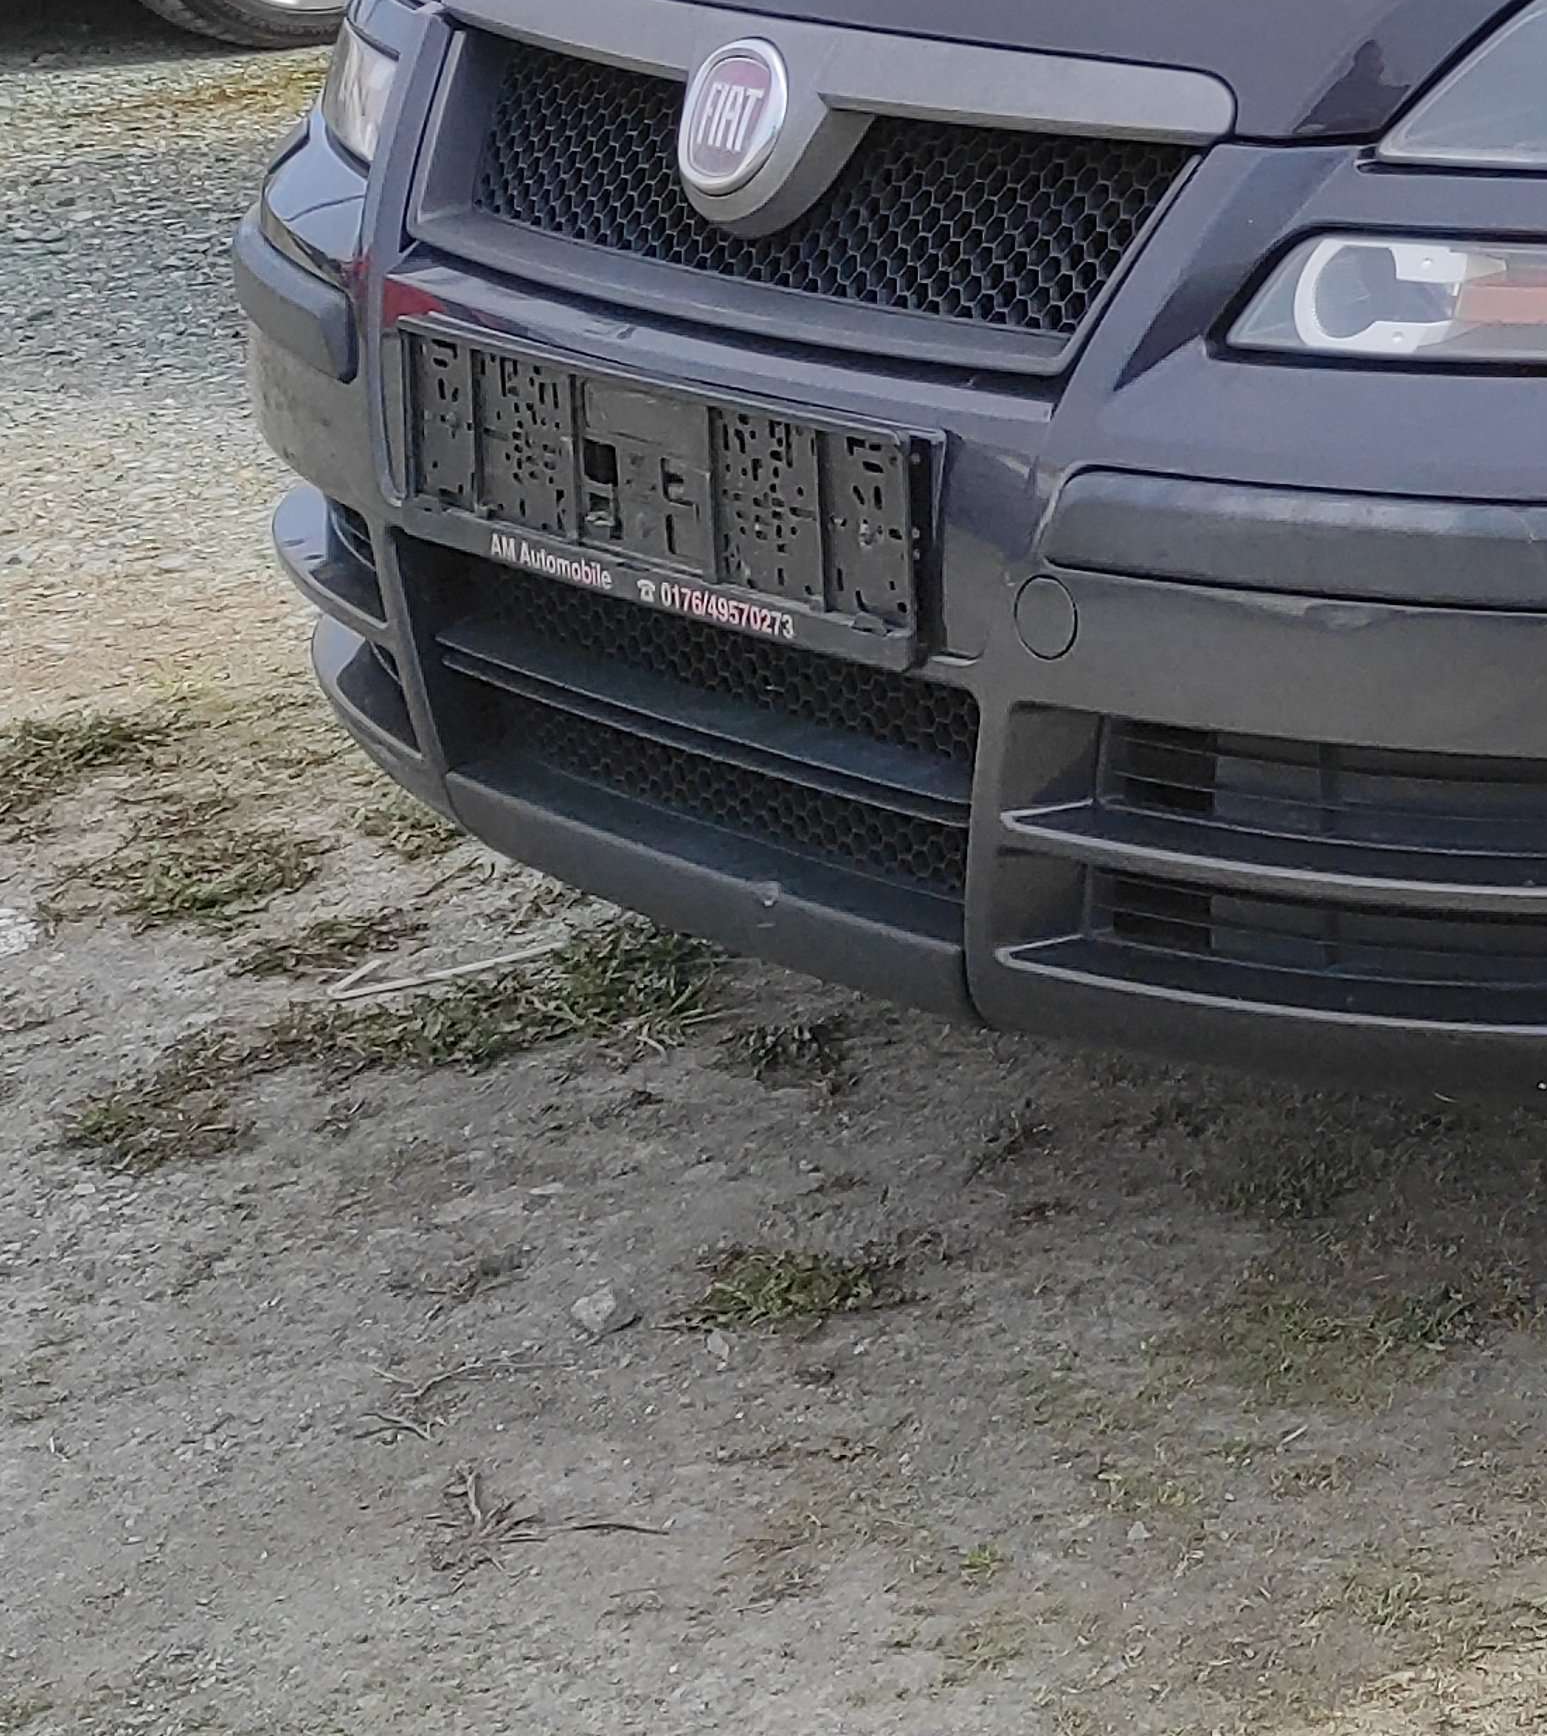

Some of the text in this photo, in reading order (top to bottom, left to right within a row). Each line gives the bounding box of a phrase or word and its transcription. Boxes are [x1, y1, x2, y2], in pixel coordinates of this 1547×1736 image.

[696, 81, 765, 153] FIAT
[490, 532, 613, 591] AM Automobile
[660, 581, 795, 640] 0176/49570273
